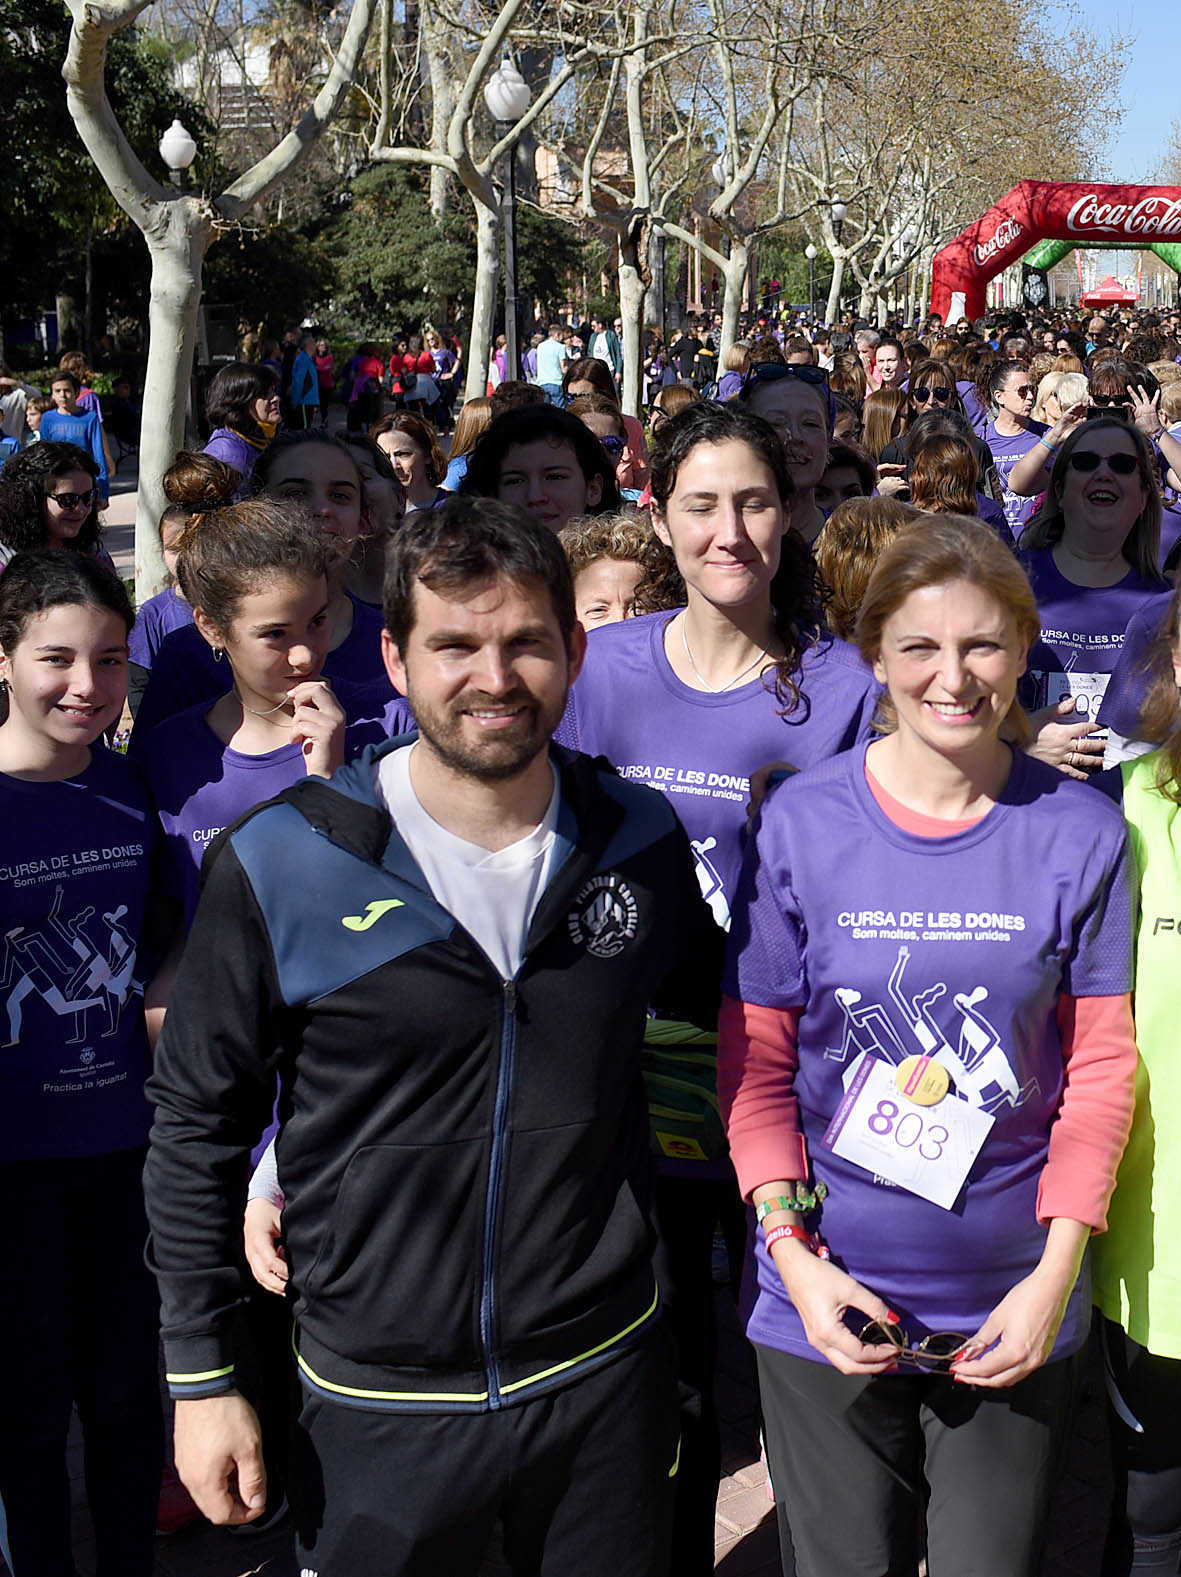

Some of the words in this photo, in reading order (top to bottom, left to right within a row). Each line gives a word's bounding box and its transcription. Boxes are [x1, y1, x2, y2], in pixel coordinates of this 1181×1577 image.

[974, 215, 1021, 266] Coca-Cola
[1040, 629, 1070, 640] URSA
[1072, 633, 1086, 642] DE
[1088, 635, 1109, 644] LES
[654, 766, 675, 780] DE
[677, 769, 705, 784] LES
[707, 773, 750, 792] DONE
[670, 783, 711, 796] caminem
[712, 789, 743, 802] unides
[0, 860, 49, 881] CURSA
[51, 855, 70, 869] DE
[73, 850, 99, 865] LES
[102, 844, 144, 860] DONES
[14, 878, 36, 888] Som
[38, 870, 70, 883] moltes,
[71, 862, 111, 876] caminem
[837, 911, 897, 927] CURSA
[900, 912, 923, 927] DE
[928, 912, 961, 928] LES
[965, 913, 1026, 931] DONES
[852, 928, 877, 940] Som
[879, 929, 920, 941] moltes,
[922, 930, 972, 941] caminem
[974, 930, 1011, 942] unides
[868, 1100, 949, 1160] 803
